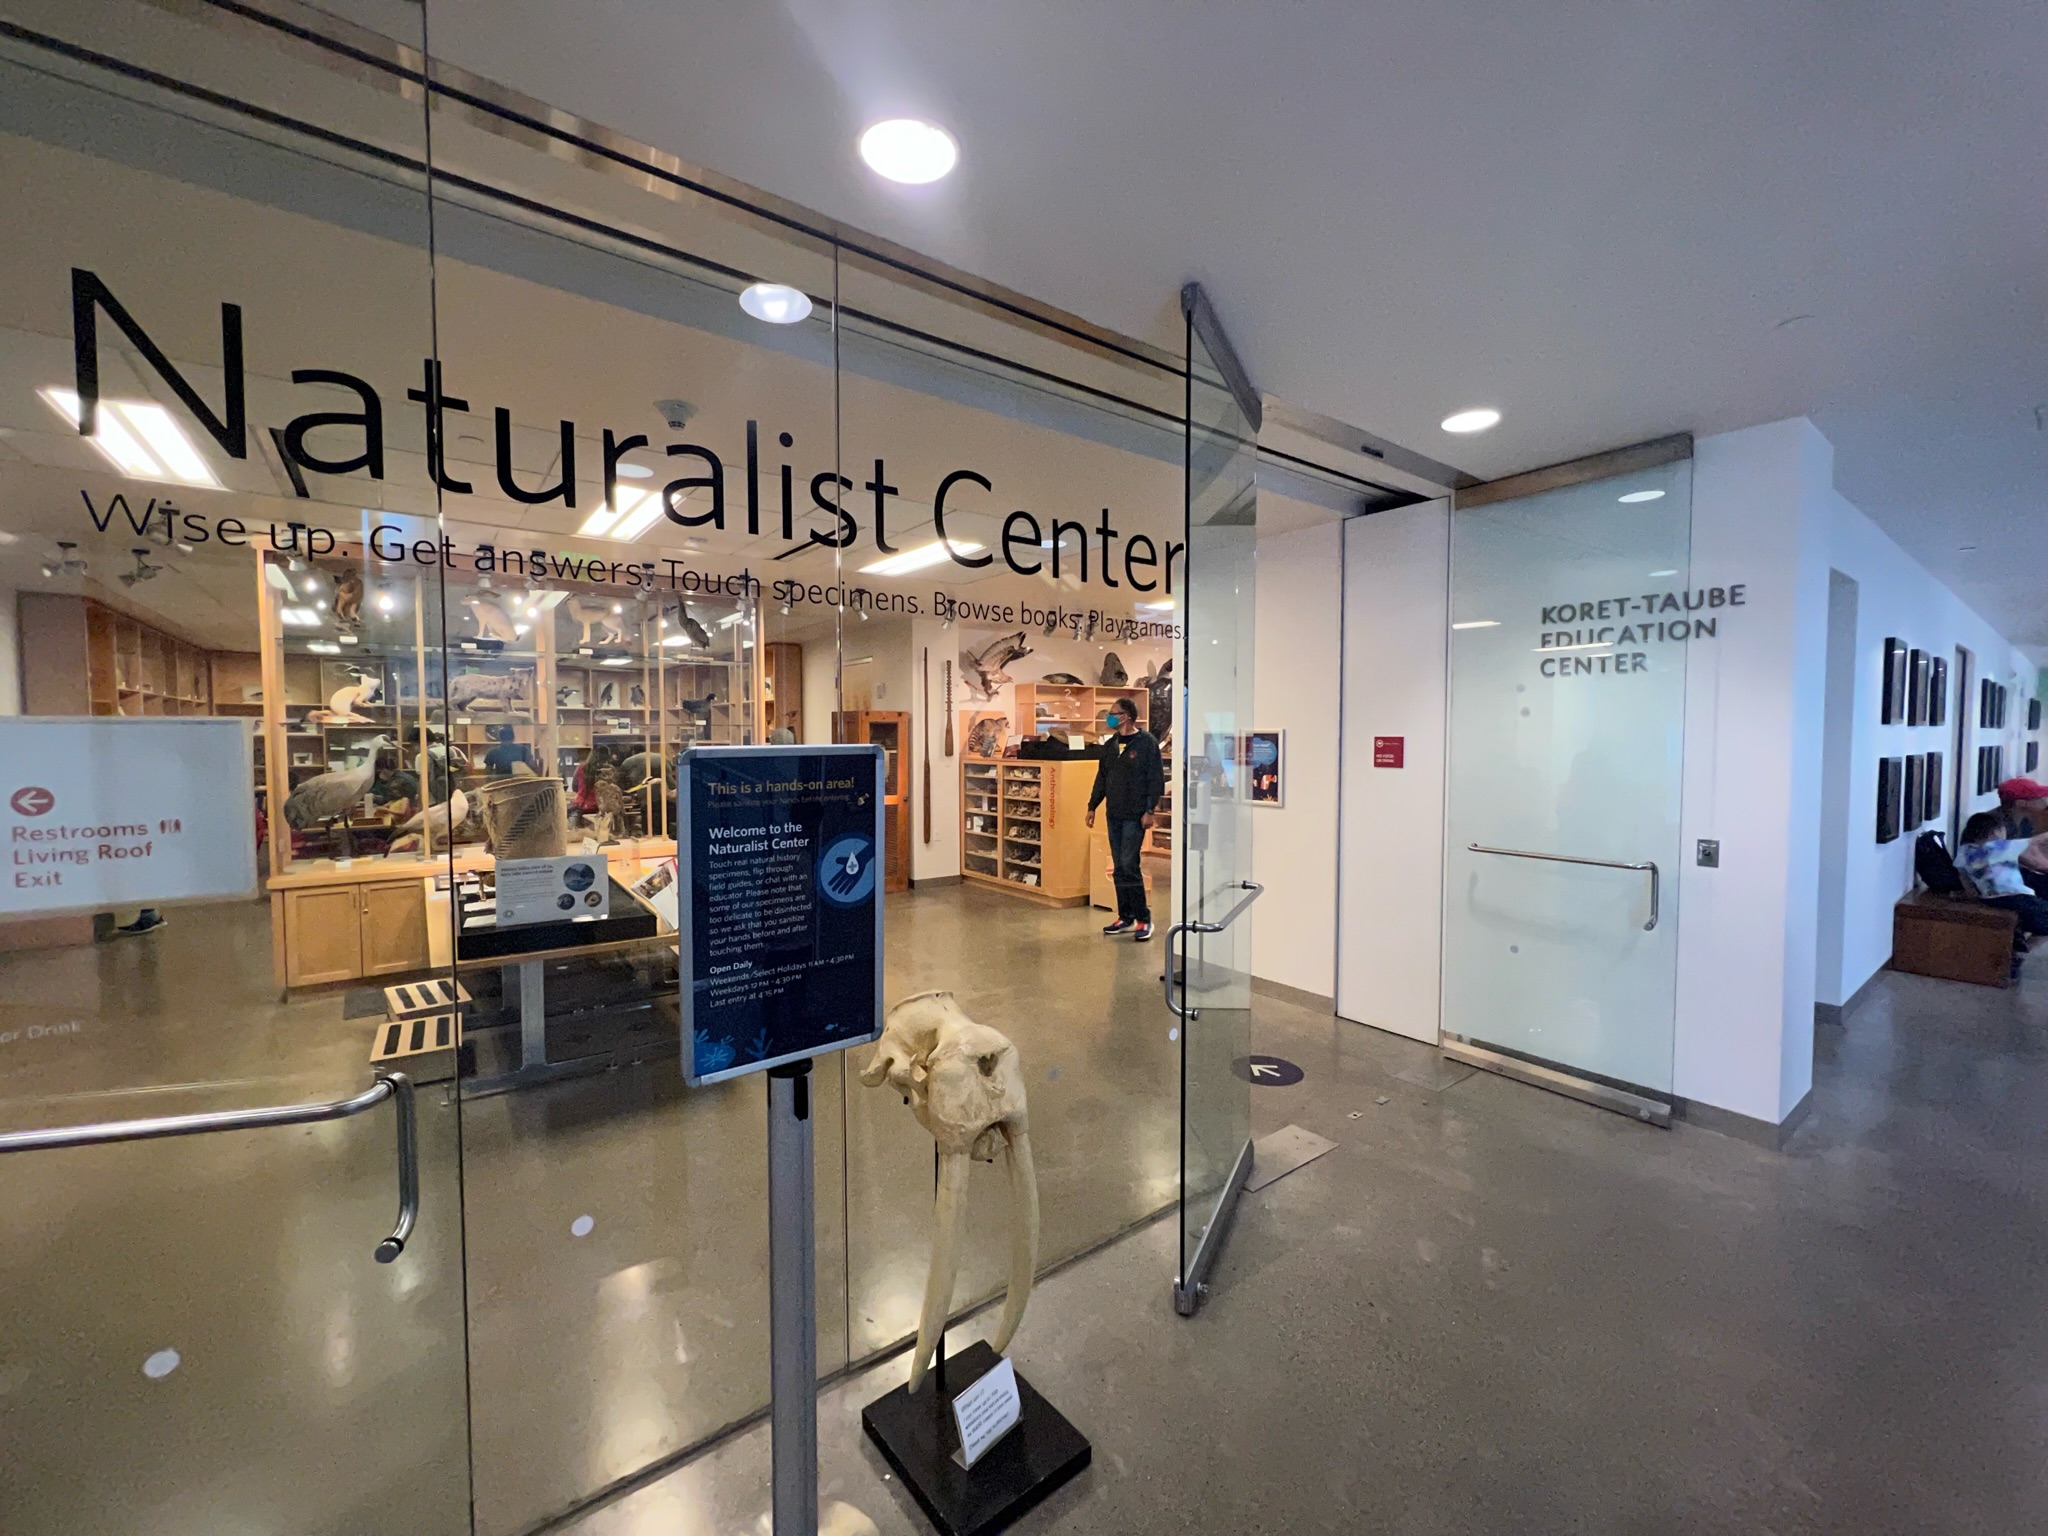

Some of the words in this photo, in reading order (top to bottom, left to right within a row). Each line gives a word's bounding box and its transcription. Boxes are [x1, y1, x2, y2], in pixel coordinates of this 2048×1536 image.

[71, 267, 899, 555] Naturalist
[934, 469, 1185, 594] Center
[81, 489, 246, 546] Wise
[270, 522, 348, 562] up.
[370, 525, 457, 568] Get
[662, 559, 761, 598] Touch
[773, 579, 925, 615] specimens.
[934, 591, 1014, 622] Browse
[1089, 609, 1125, 639] Play
[1541, 584, 1746, 625] KORET-TAUBE
[1541, 617, 1717, 649] EDUCATION
[1540, 652, 1649, 679] CENTER
[708, 782, 737, 795] This
[741, 781, 751, 794] is
[755, 783, 763, 793] a
[766, 779, 823, 792] hands-on
[826, 777, 855, 789] area!
[708, 800, 732, 809] Please
[762, 798, 778, 807] your
[12, 823, 148, 843] Restrooms
[709, 826, 766, 839] Welcome
[769, 824, 781, 834] to
[784, 822, 803, 833] the
[14, 848, 89, 866] Living
[98, 841, 153, 861] Roof
[709, 840, 768, 855] Naturalist
[772, 837, 809, 849] Center
[709, 860, 732, 869] Touch
[734, 858, 748, 867] real
[750, 855, 775, 865] natural
[777, 853, 800, 863] history
[753, 867, 764, 877] flip
[766, 864, 793, 874] through
[15, 871, 63, 888] Exit
[709, 882, 726, 891] field
[765, 876, 780, 884] chat
[783, 874, 797, 882] with
[746, 889, 769, 897] Please
[788, 884, 802, 892] that
[709, 905, 730, 913] some
[732, 902, 740, 910] of
[755, 896, 793, 907] specimens
[724, 912, 753, 922] delicate
[763, 908, 773, 916] be
[733, 922, 746, 931] ask
[748, 920, 762, 929] that
[764, 920, 777, 928] you
[779, 915, 805, 924] sanitize
[709, 938, 726, 947] your
[728, 933, 751, 943] hands
[752, 929, 775, 939] before
[777, 926, 790, 935] and
[792, 924, 808, 933] after
[709, 945, 742, 957] touching
[709, 965, 731, 975] Open
[733, 960, 752, 970] Daily
[777, 963, 807, 973] Holidays
[710, 985, 749, 997] Weekdays
[710, 999, 726, 1008] Last
[728, 993, 747, 1005] entry
[749, 992, 756, 1000] at
[774, 987, 784, 995] PM
[0, 1031, 20, 1043] or
[27, 1020, 82, 1039] Drink
